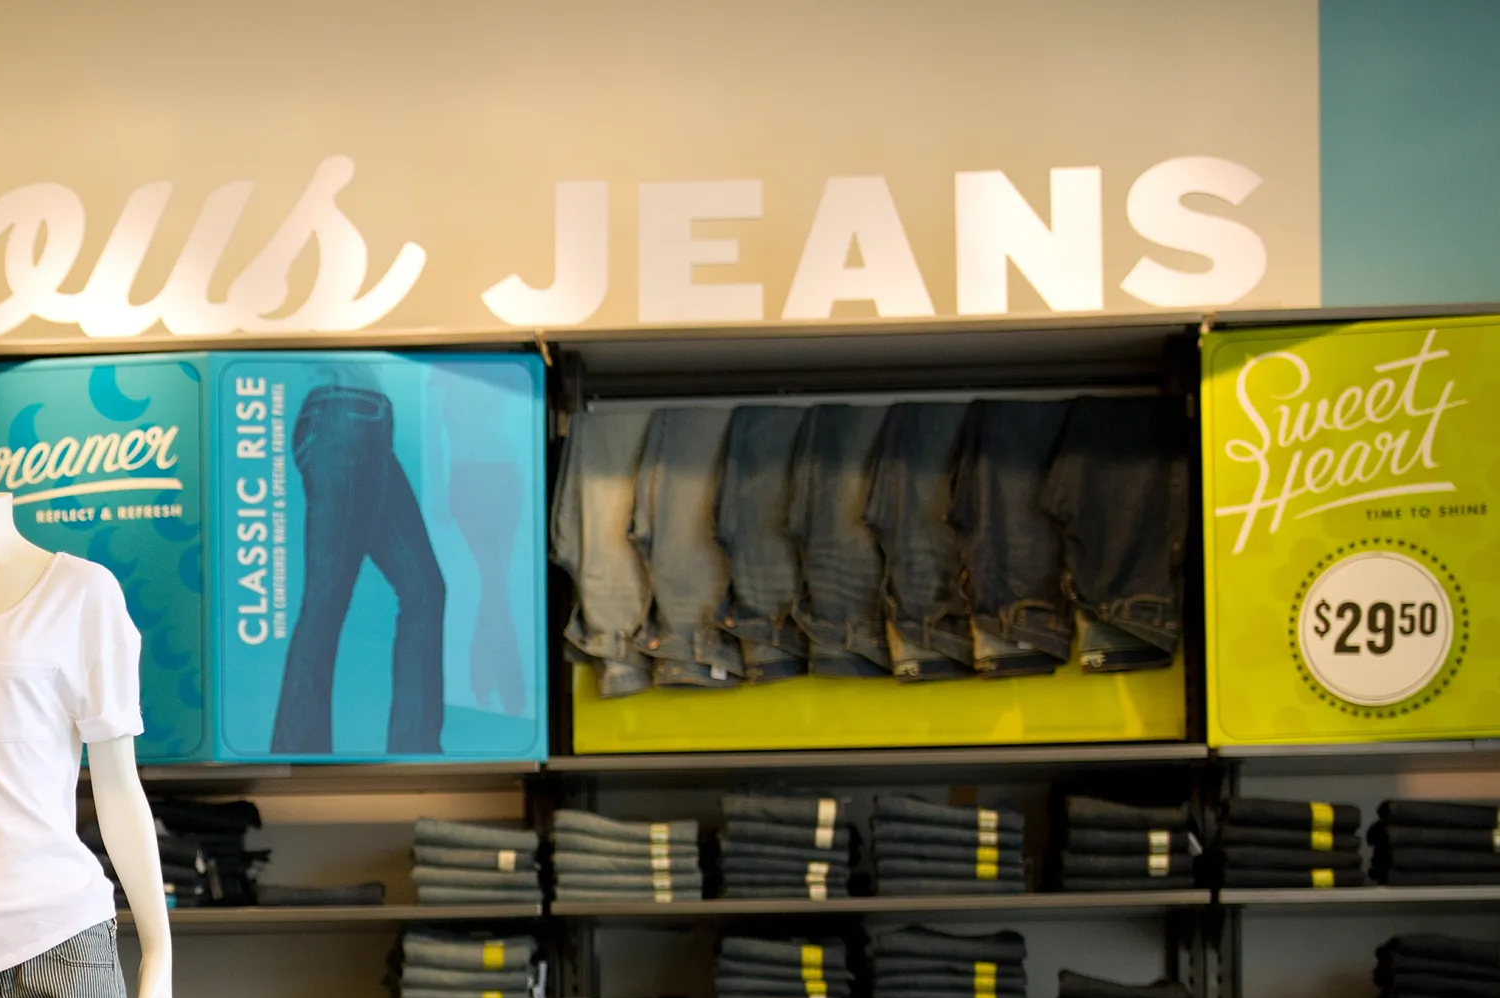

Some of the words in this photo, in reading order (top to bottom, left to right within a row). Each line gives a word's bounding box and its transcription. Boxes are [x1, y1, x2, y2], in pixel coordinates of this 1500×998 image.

[480, 155, 1267, 327] JEANS
[235, 377, 267, 459] RISE
[1224, 328, 1458, 462] Sweet
[35, 507, 96, 524] REFLECT
[100, 507, 113, 521] &
[117, 505, 183, 520] REFRESH
[1215, 379, 1469, 555] Heart
[1366, 505, 1402, 521] TIME
[1411, 505, 1431, 520] TO
[1439, 502, 1488, 518] SHINE
[236, 477, 269, 645] CLASSIC
